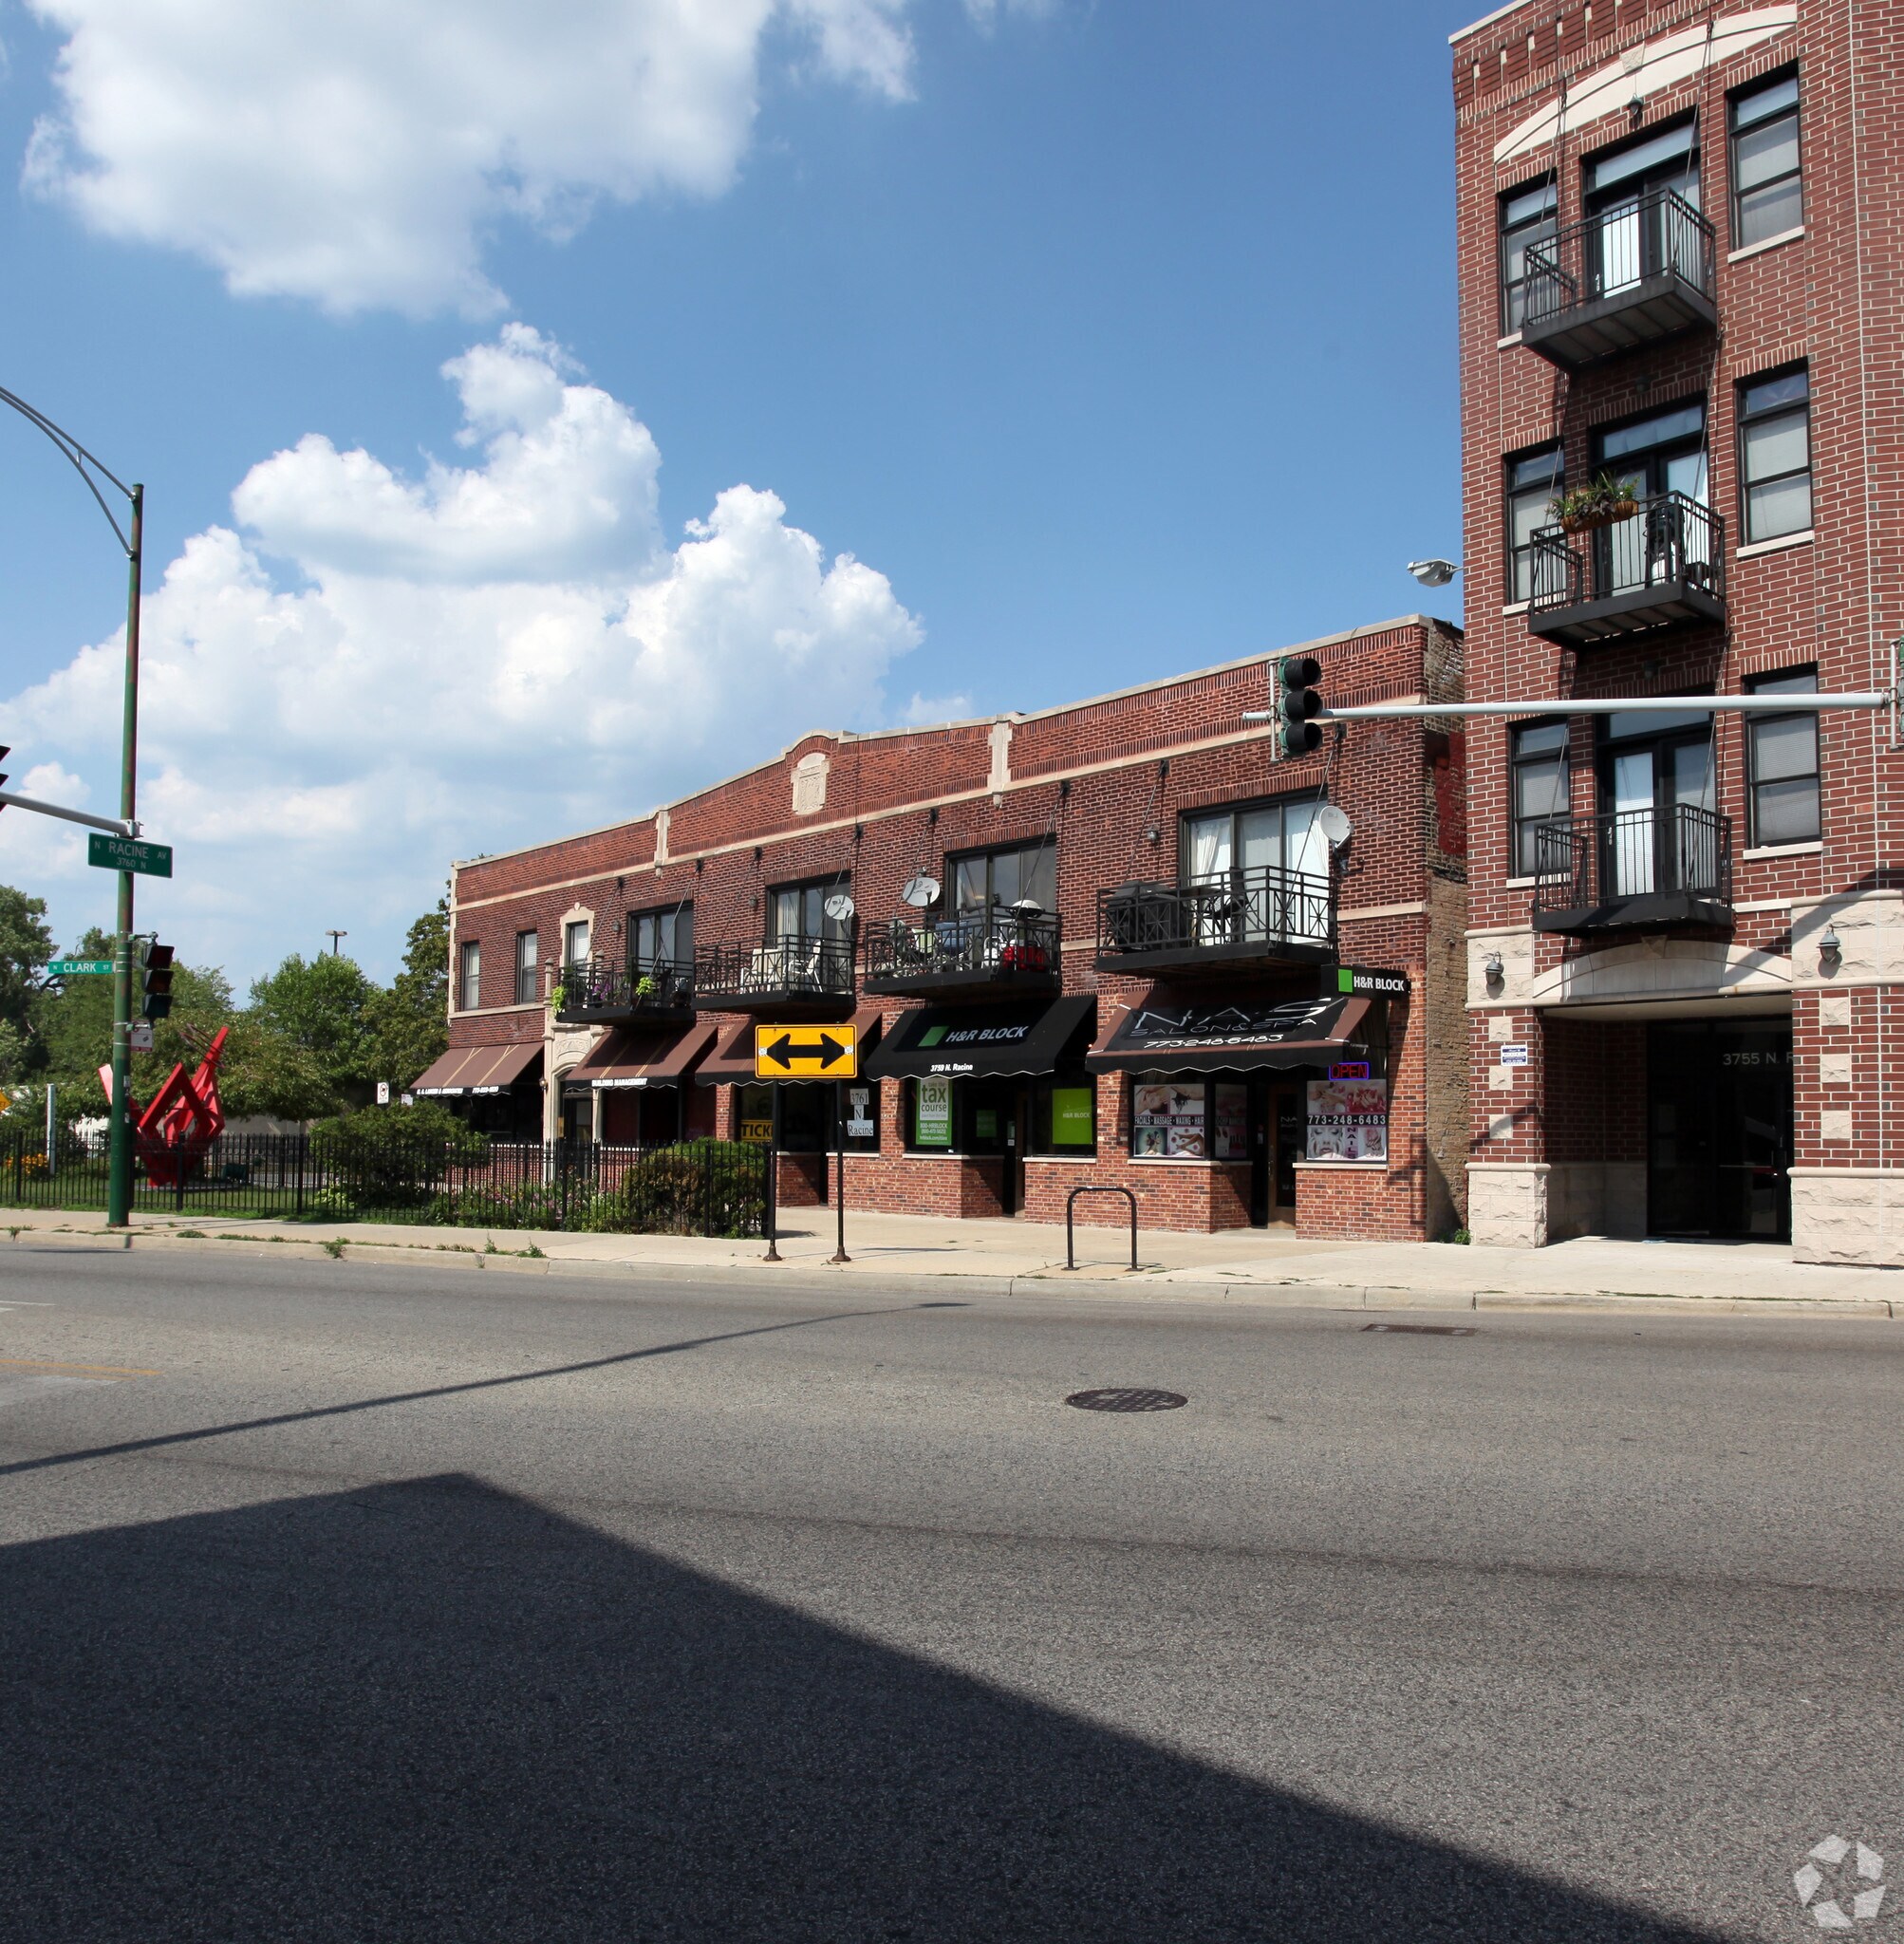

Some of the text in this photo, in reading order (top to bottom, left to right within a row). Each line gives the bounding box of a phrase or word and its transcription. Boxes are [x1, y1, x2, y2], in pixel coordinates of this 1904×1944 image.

[94, 841, 167, 860] N RACINE AV
[116, 857, 147, 869] 3760 N
[63, 963, 97, 973] CLARK
[1353, 976, 1405, 992] H&R BLOCK
[945, 1025, 1029, 1042] H&R BLOCK
[1723, 1053, 1760, 1065] 3755
[952, 1062, 974, 1072] Racine
[1332, 1064, 1367, 1078] OPEN
[850, 1093, 868, 1103] 3761
[922, 1085, 946, 1103] tax
[1153, 1115, 1173, 1126] MASSAGE
[1308, 1114, 1386, 1125] 773-248-6483
[849, 1124, 873, 1135] Racine
